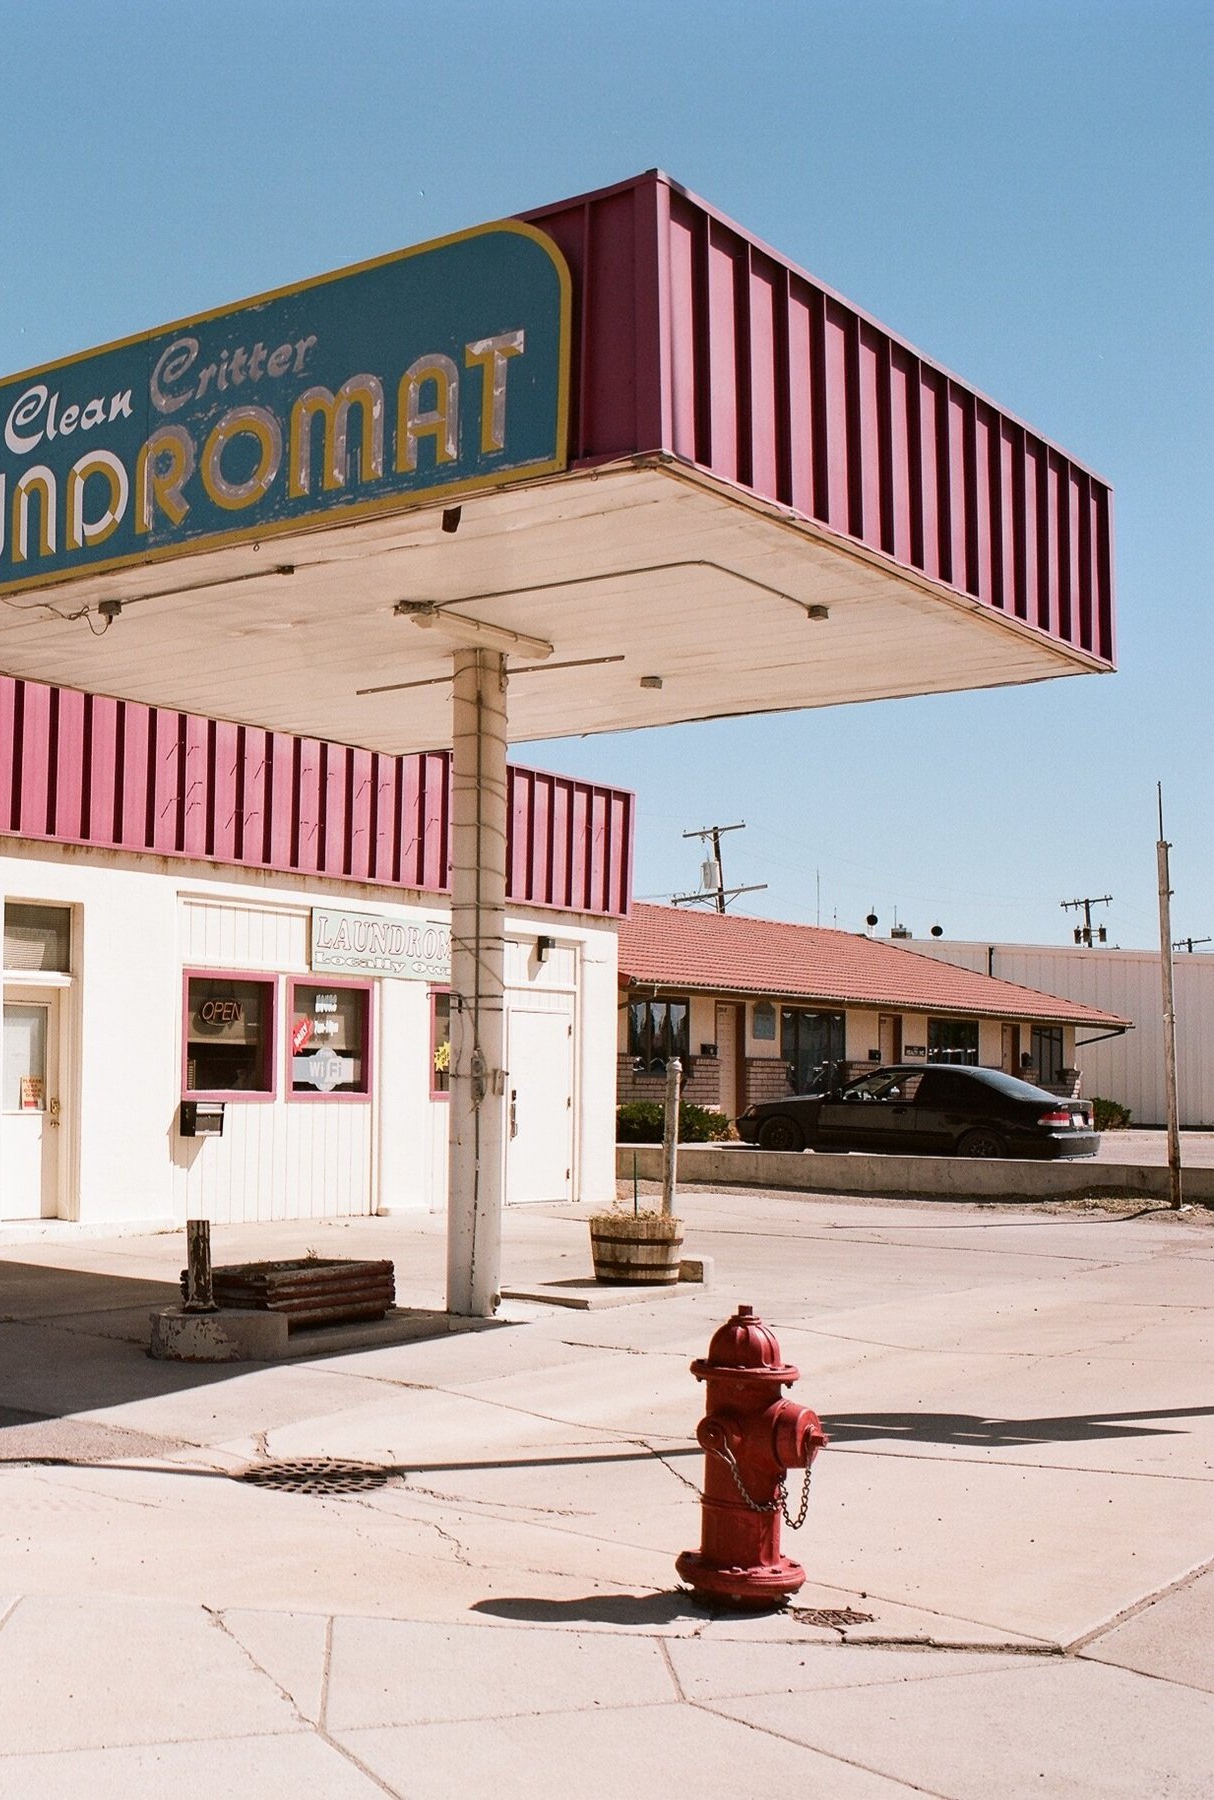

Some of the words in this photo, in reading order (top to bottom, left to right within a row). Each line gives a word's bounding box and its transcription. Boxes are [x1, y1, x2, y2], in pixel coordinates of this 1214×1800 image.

[4, 384, 134, 455] Clean
[150, 331, 319, 415] Critter
[315, 952, 407, 974] Locally
[202, 1000, 243, 1020] OPEN
